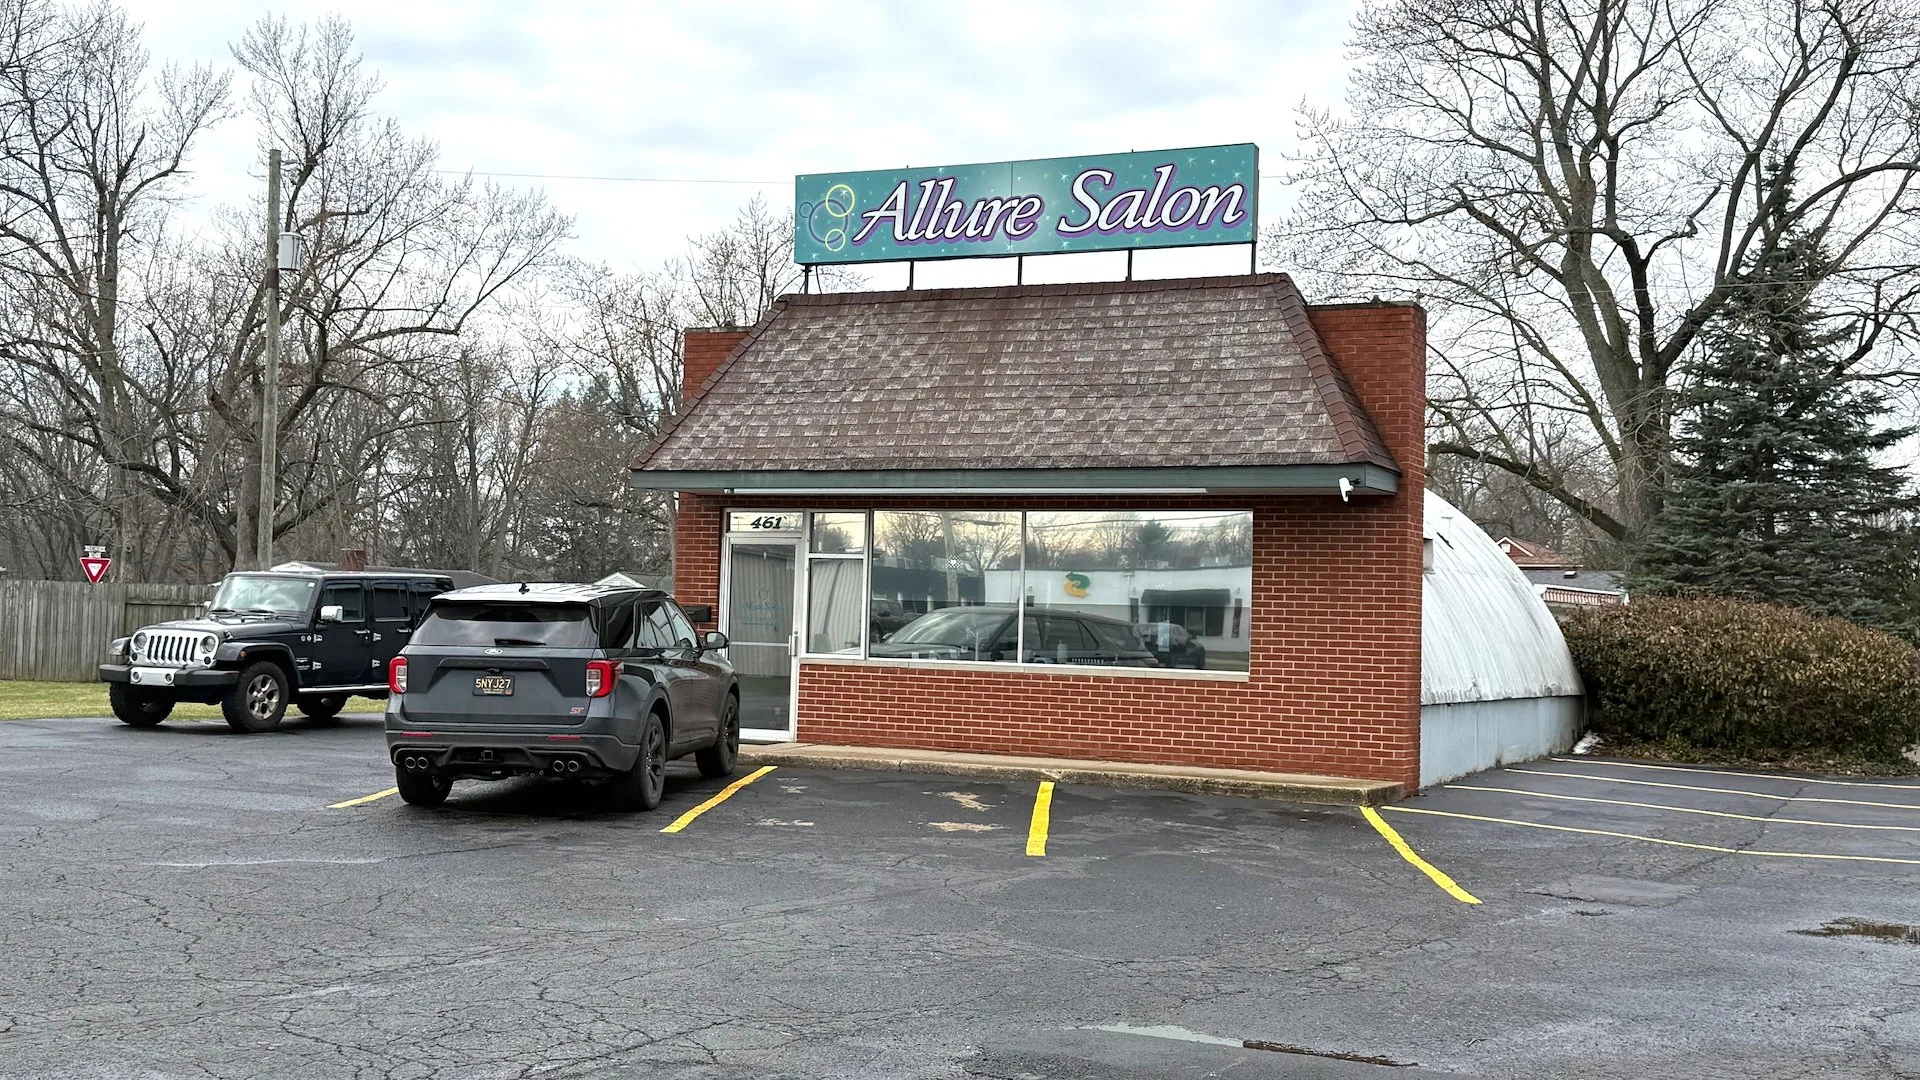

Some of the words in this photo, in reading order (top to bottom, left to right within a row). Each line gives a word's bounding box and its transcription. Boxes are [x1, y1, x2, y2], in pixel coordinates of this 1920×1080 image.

[852, 177, 1043, 244] Allure
[1056, 163, 1245, 236] Salon
[750, 516, 782, 529] 461
[475, 678, 511, 689] 5NYJ27
